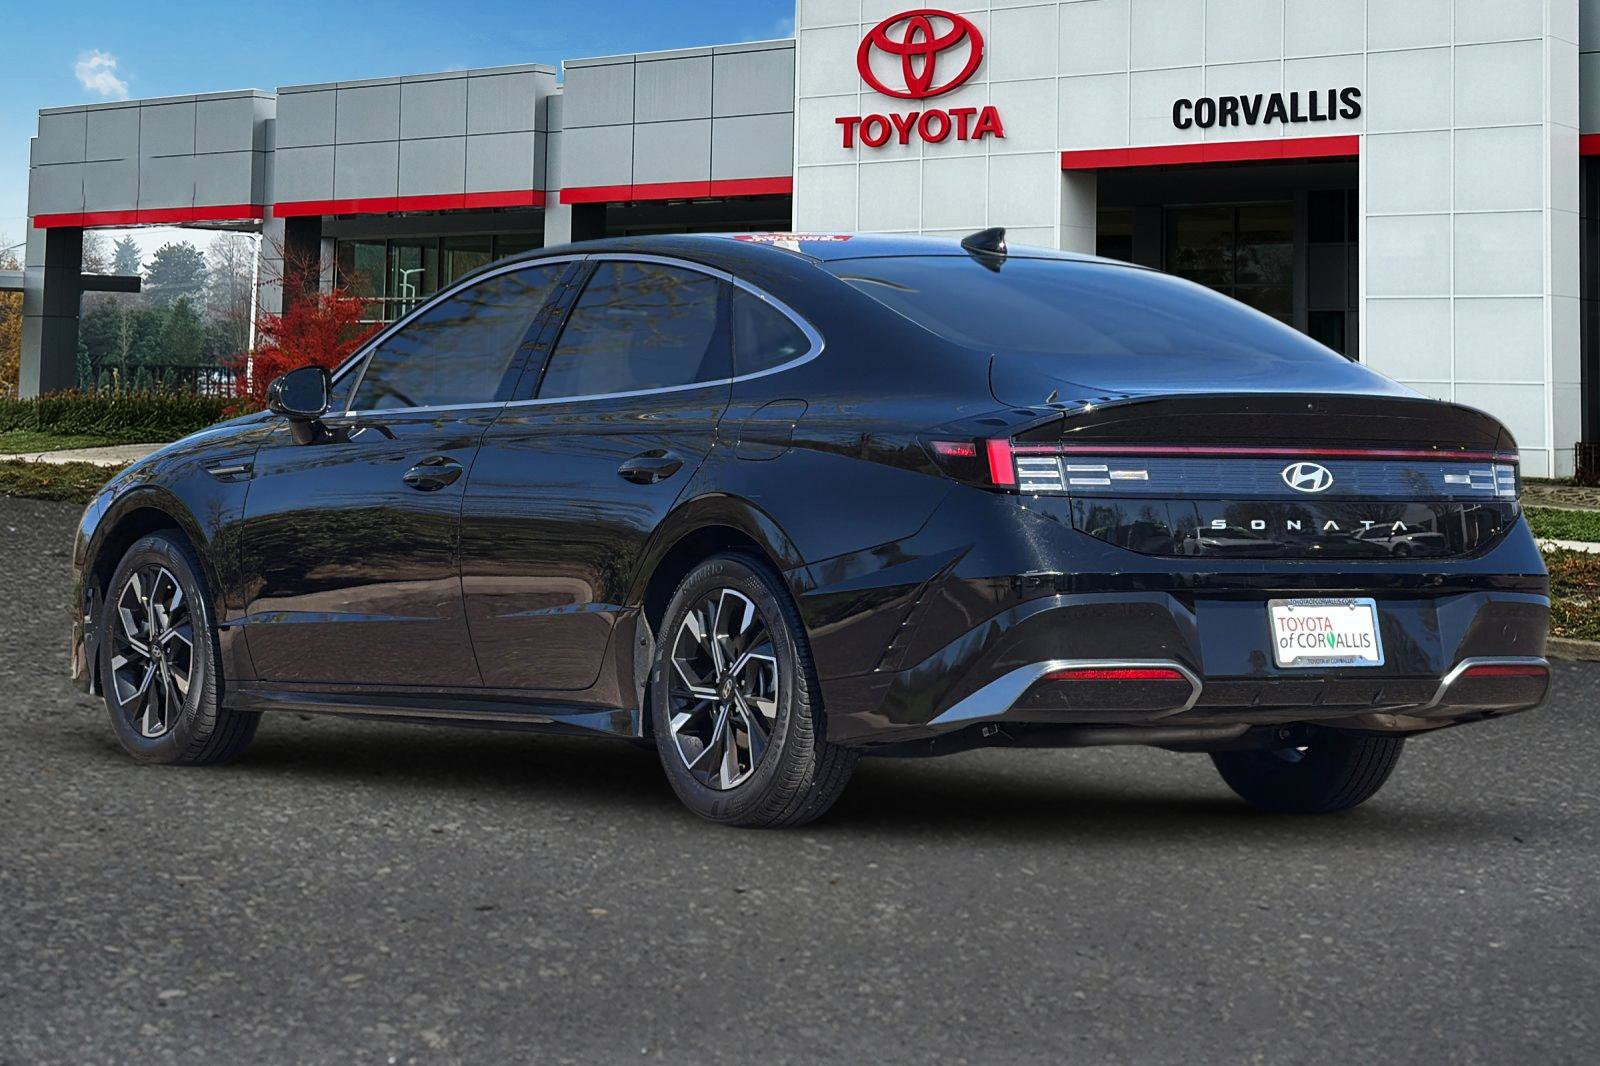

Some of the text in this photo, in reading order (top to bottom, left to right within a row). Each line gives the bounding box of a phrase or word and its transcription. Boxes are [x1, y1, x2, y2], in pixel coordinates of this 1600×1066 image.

[1172, 87, 1362, 129] CORVALLIS
[835, 106, 1005, 148] TOYOTA
[1211, 520, 1408, 530] SONATA
[1277, 616, 1334, 632] TOYOTA
[1280, 631, 1371, 649] of CORVALLIS
